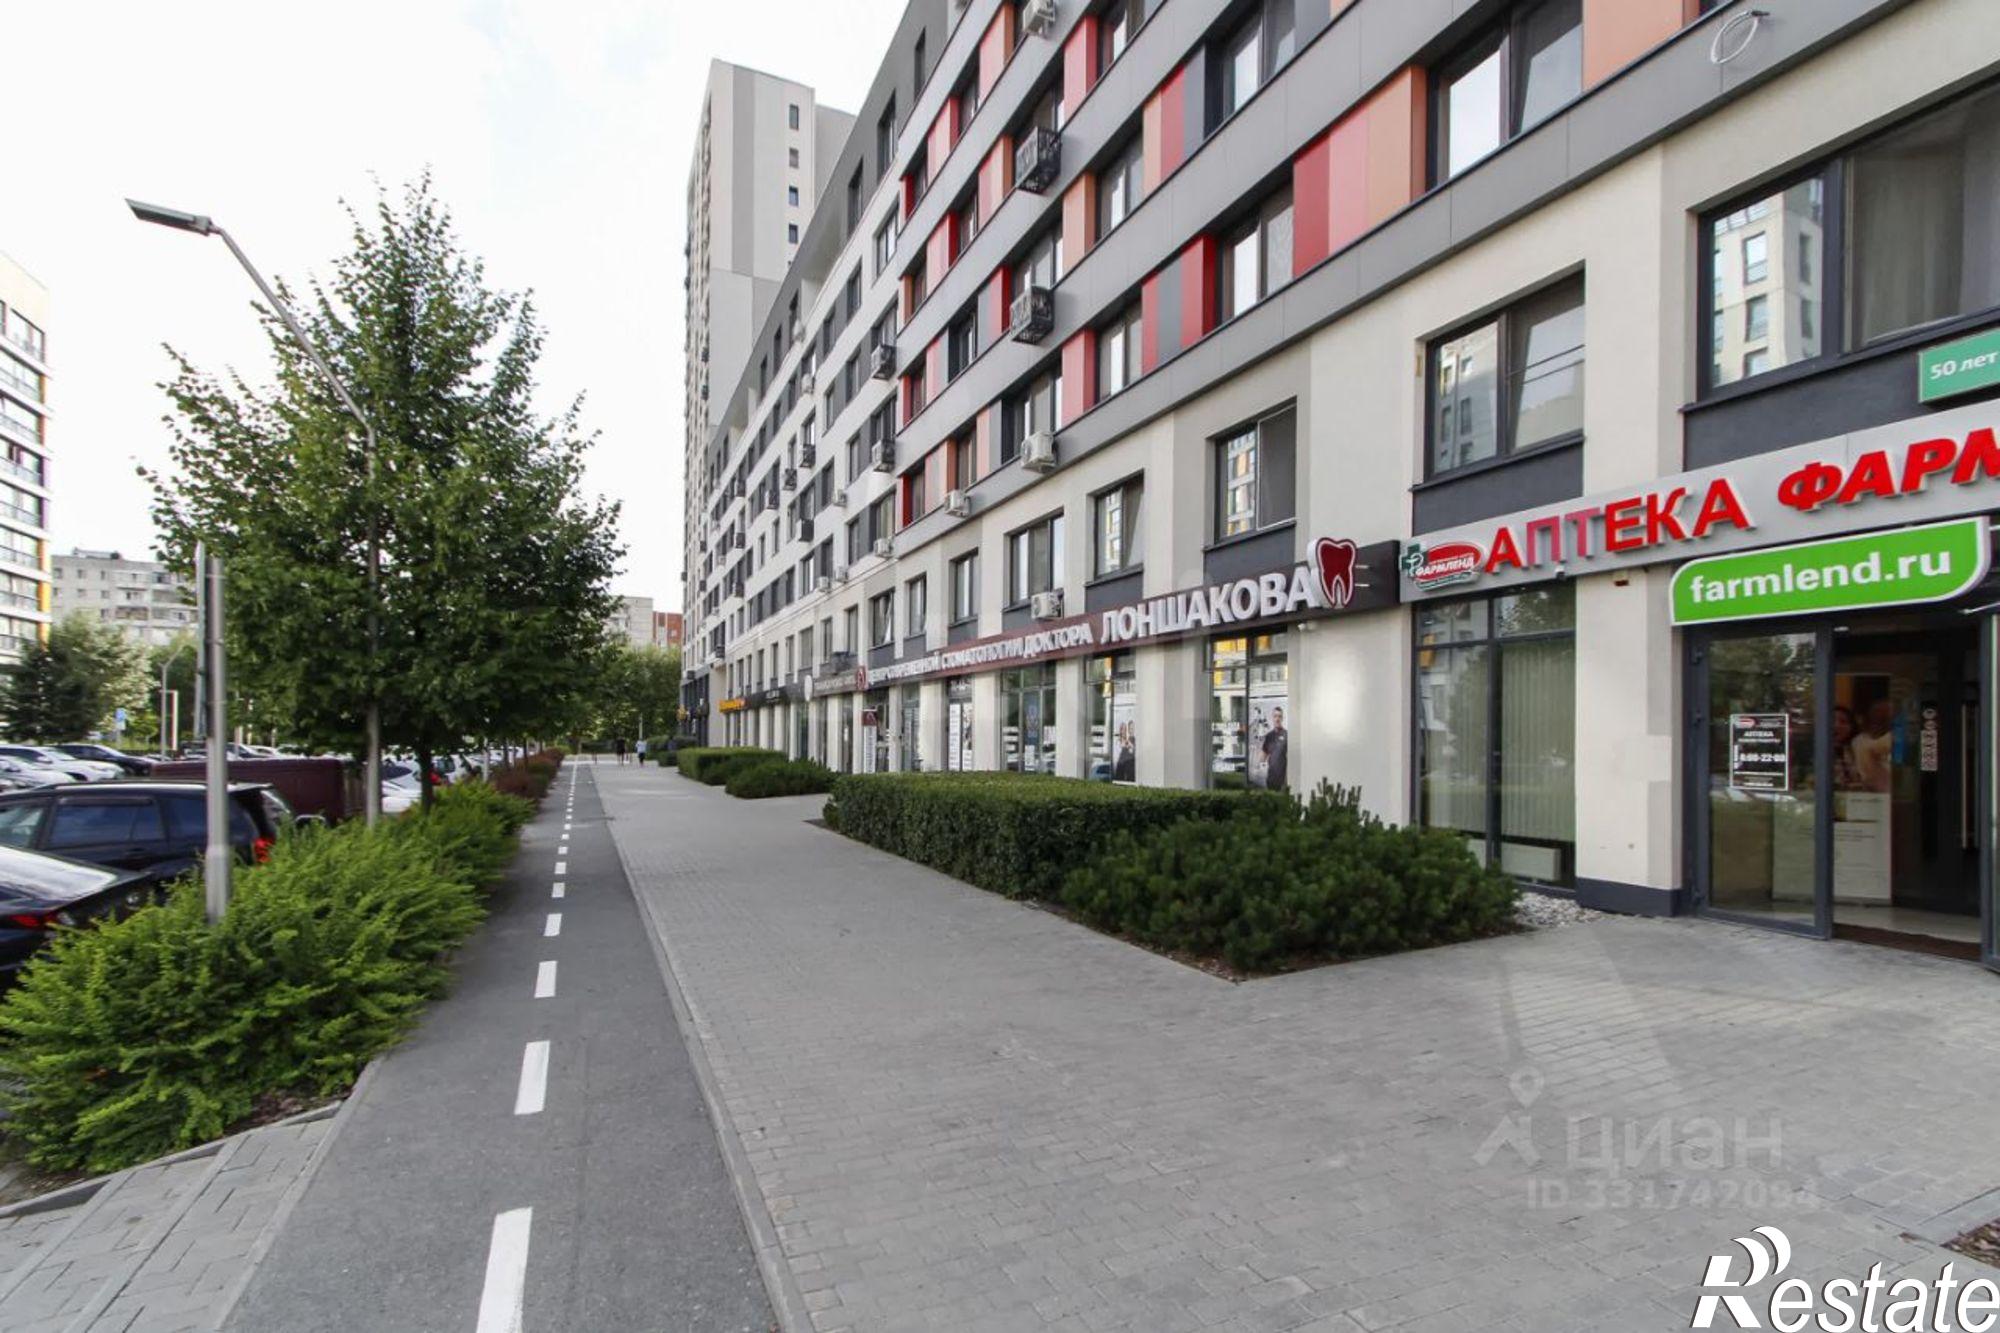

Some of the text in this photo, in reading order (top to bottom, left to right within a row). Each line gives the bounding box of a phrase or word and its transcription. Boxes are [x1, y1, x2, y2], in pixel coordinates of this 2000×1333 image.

[1930, 352, 1998, 380] 50 лет
[1484, 478, 1757, 572] АПТЕКА
[1023, 623, 1094, 658] ДОКТОРА
[1101, 565, 1320, 645] ЛОНШАКОВА
[1690, 550, 1951, 603] farmlend.ru
